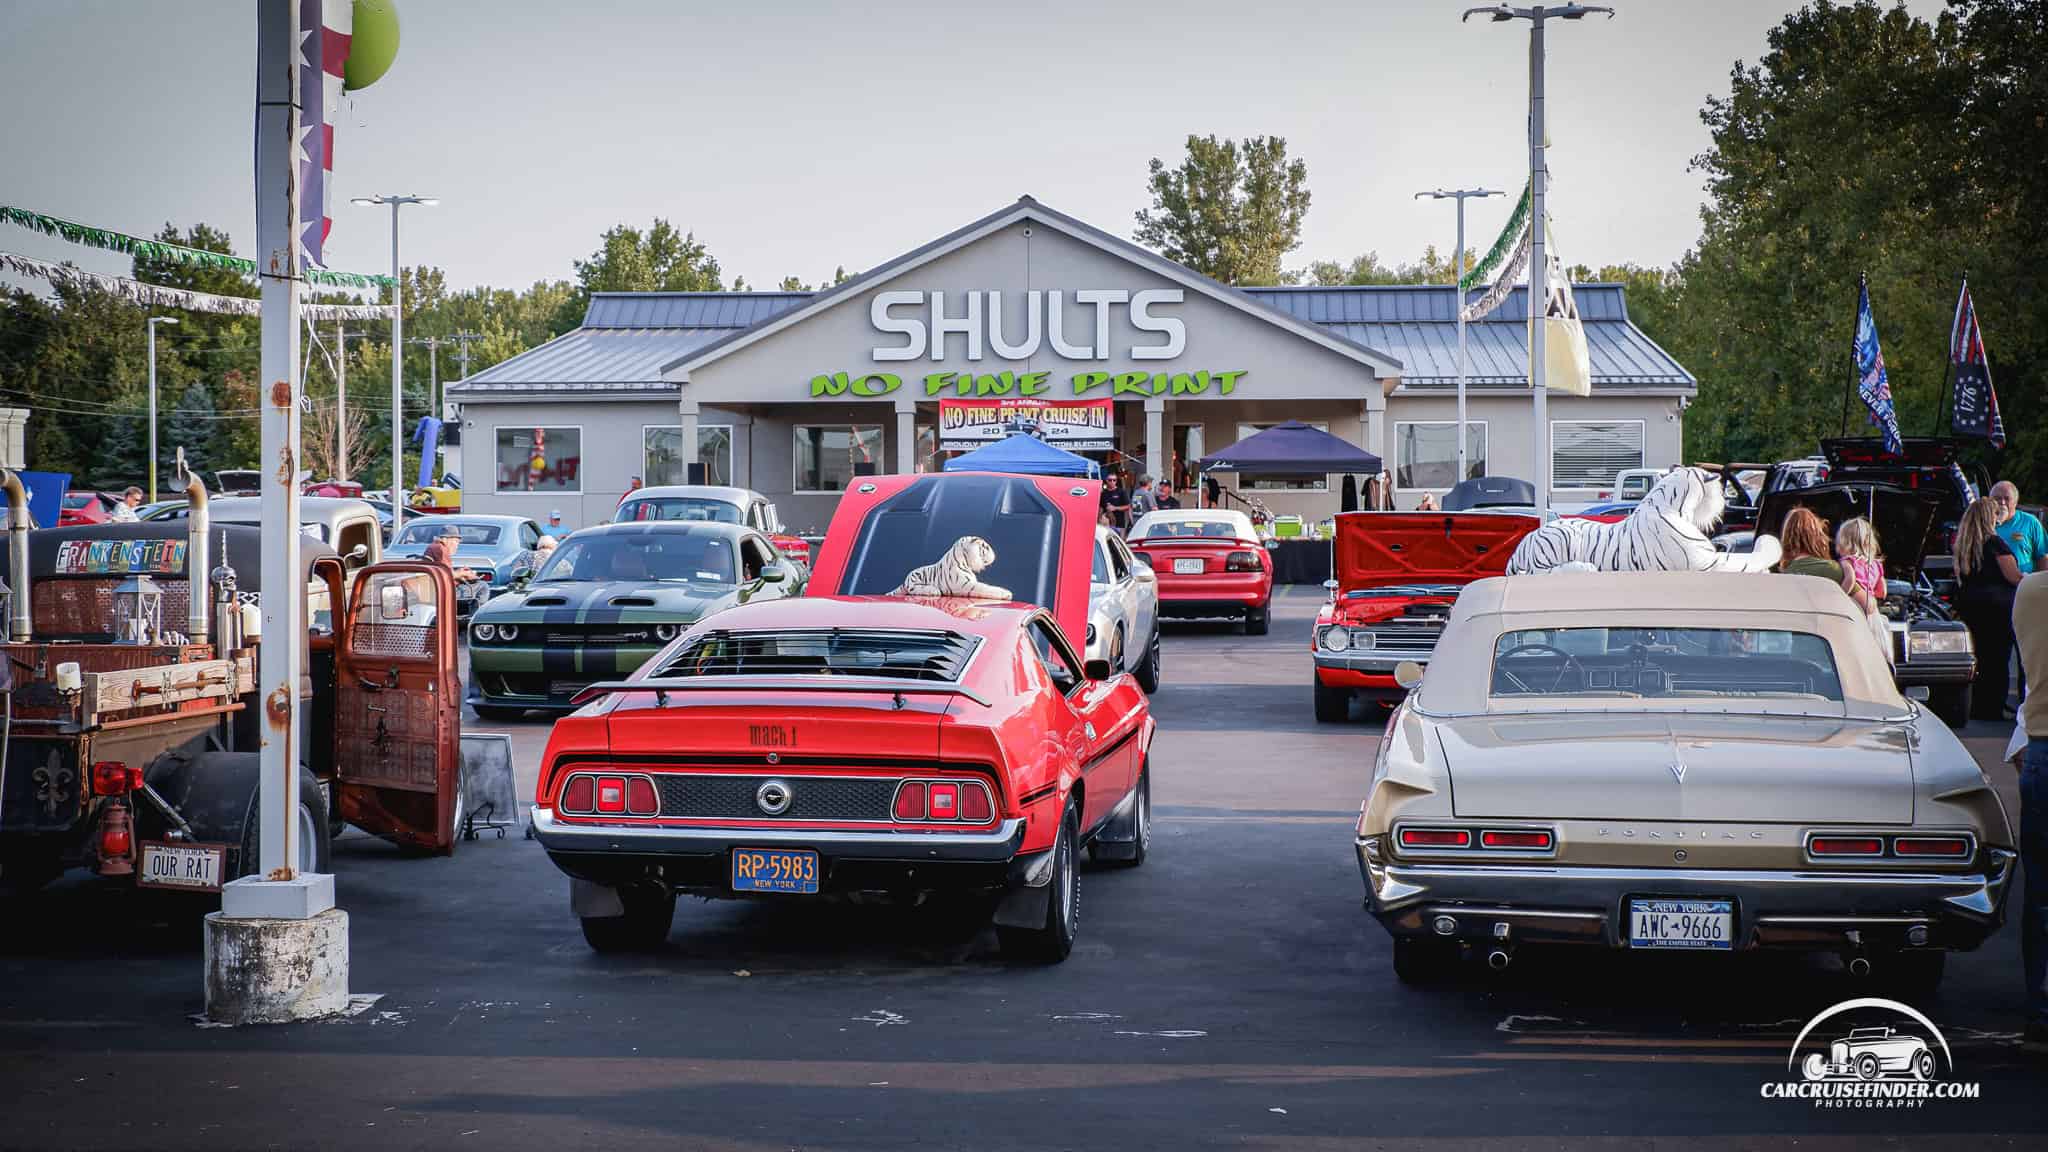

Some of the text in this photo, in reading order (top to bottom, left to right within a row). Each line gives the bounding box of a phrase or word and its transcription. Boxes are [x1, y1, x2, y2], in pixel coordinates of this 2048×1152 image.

[870, 288, 1186, 361] SHULTS
[810, 370, 1249, 397] NO FINE PRINT
[1960, 384, 1977, 412] 1776
[944, 407, 1108, 429] NO FINE PRINT CRUISE IN
[58, 541, 185, 568] FRANKENSTEIN
[791, 726, 799, 746] 1
[1598, 827, 1763, 839] PONTIAC
[152, 855, 212, 880] OUR RAT
[754, 879, 796, 888] NEW YORK
[1654, 903, 1707, 913] NEW YORK
[1640, 914, 1721, 939] AWC 9666
